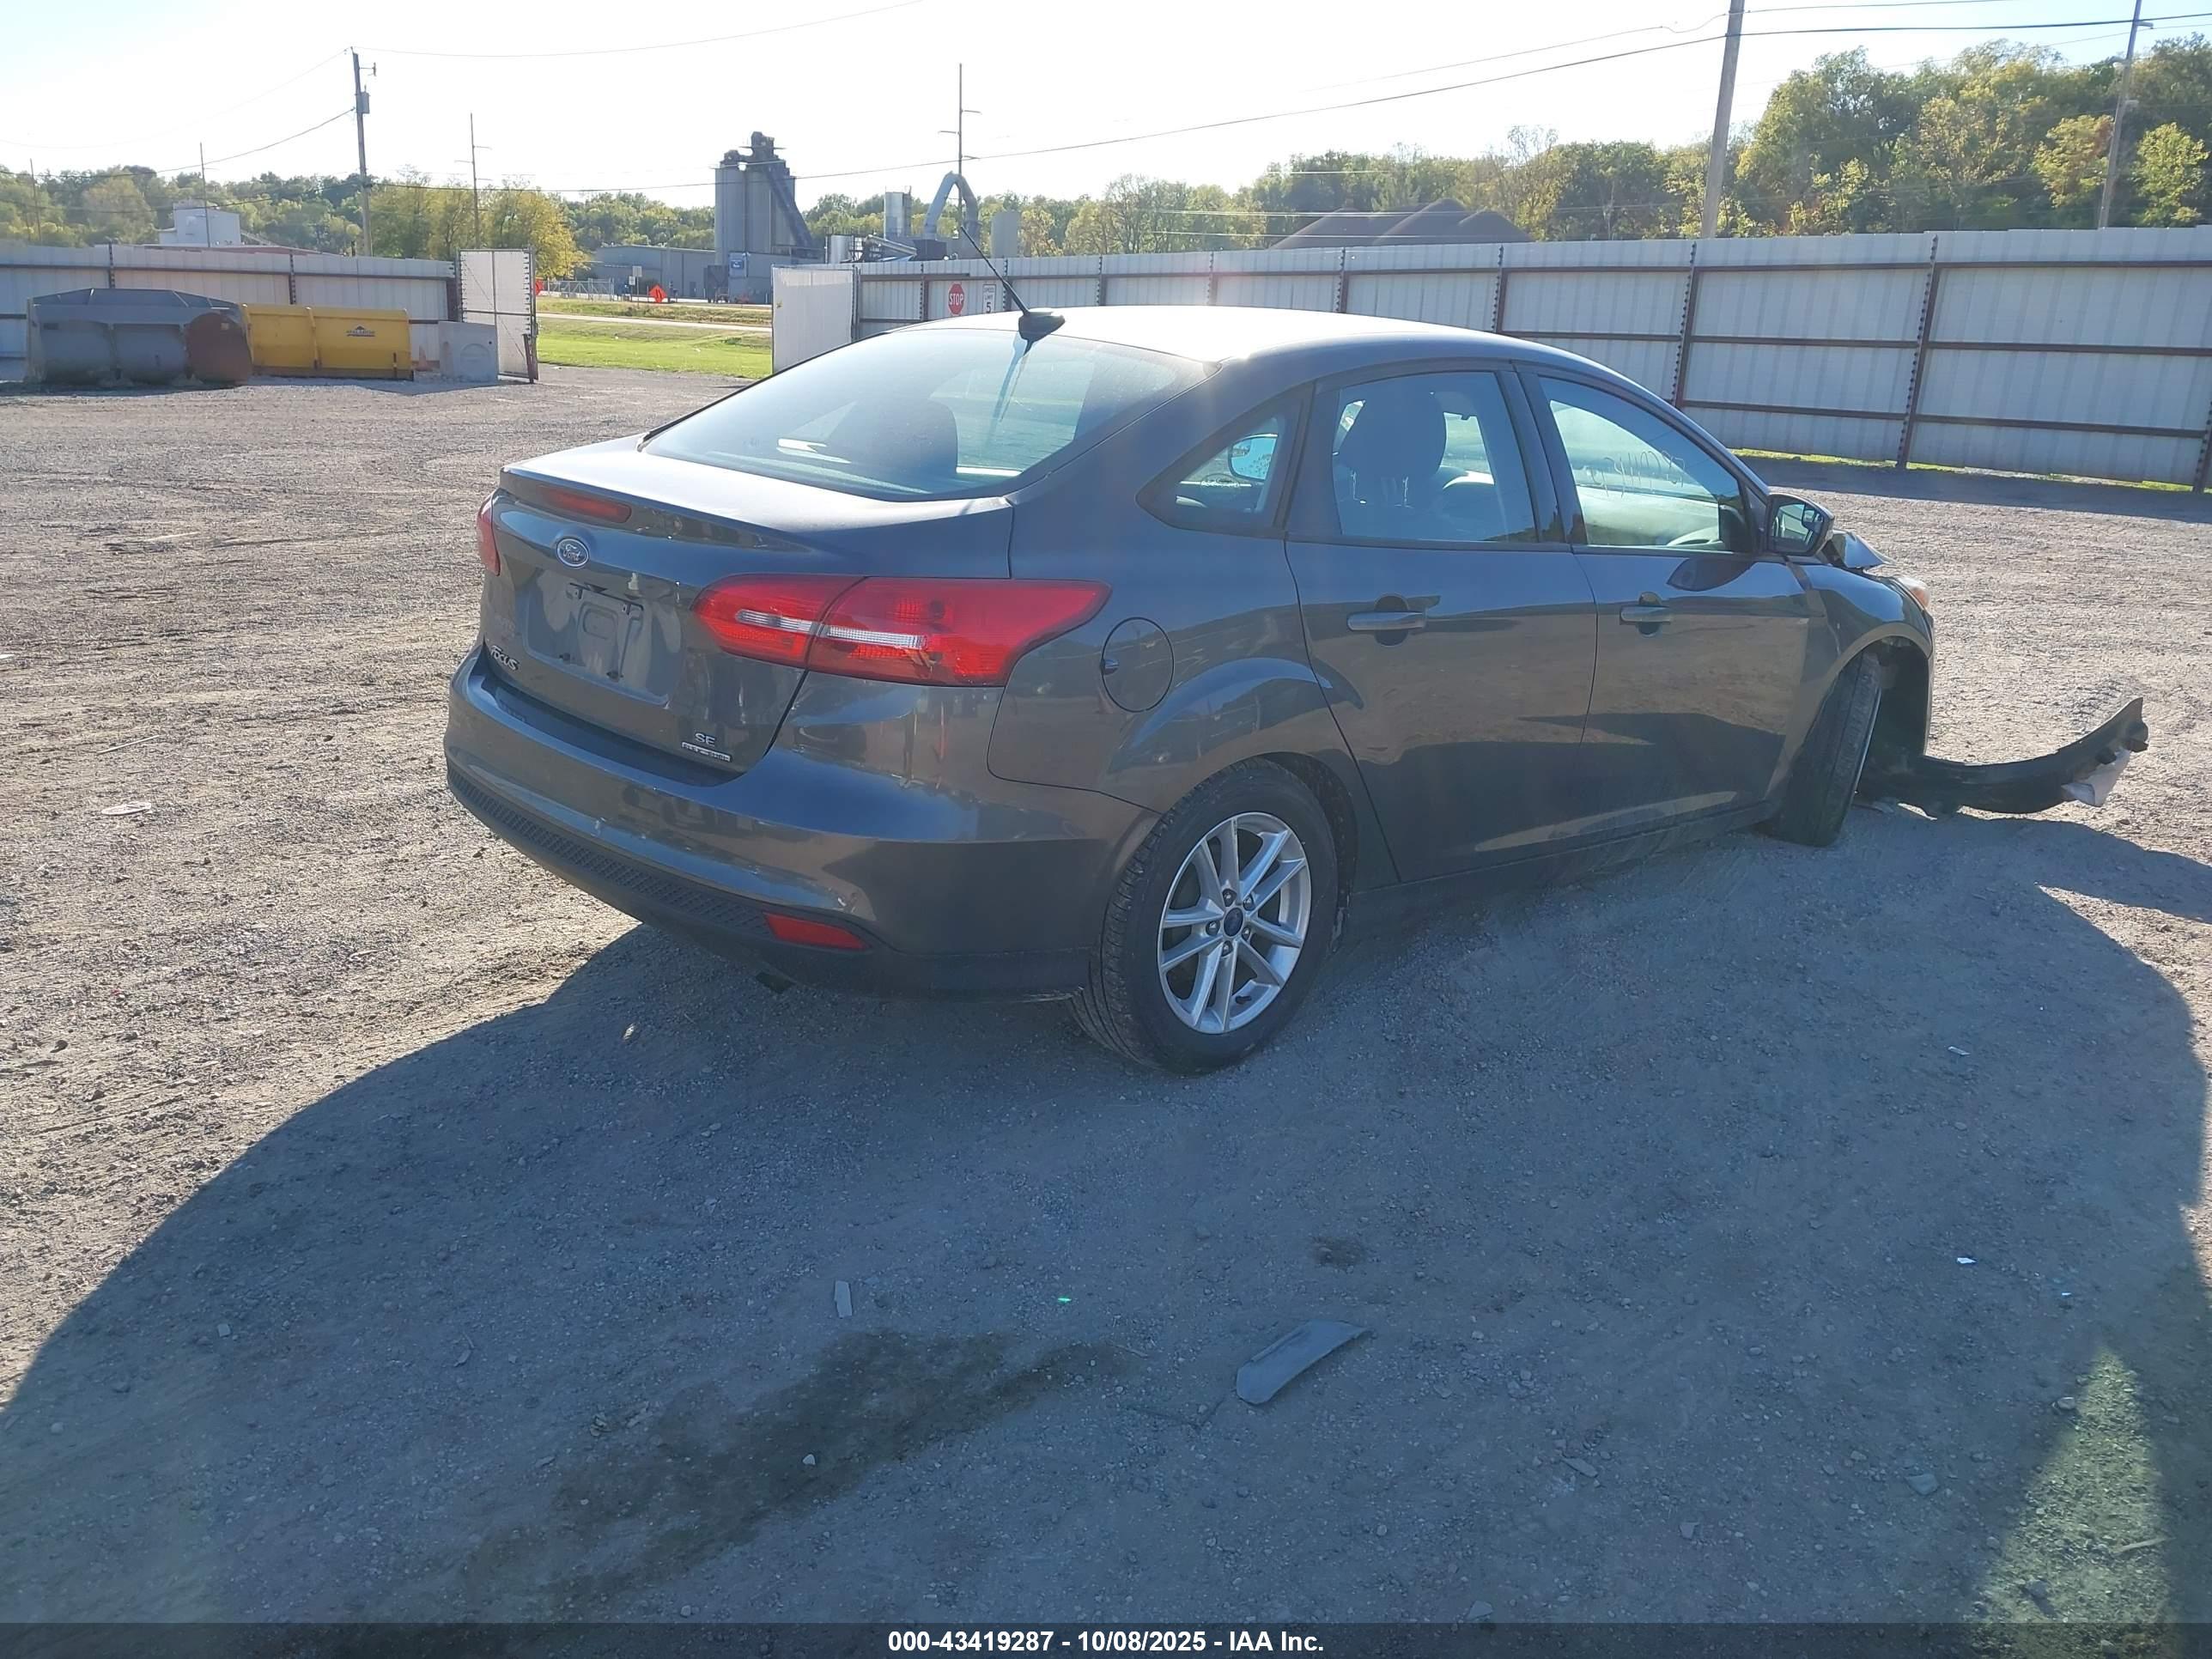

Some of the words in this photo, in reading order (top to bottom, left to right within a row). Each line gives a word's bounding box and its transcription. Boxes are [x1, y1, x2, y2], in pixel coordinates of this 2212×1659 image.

[949, 294, 964, 306] STOP
[986, 302, 992, 313] 5
[695, 732, 715, 747] SE
